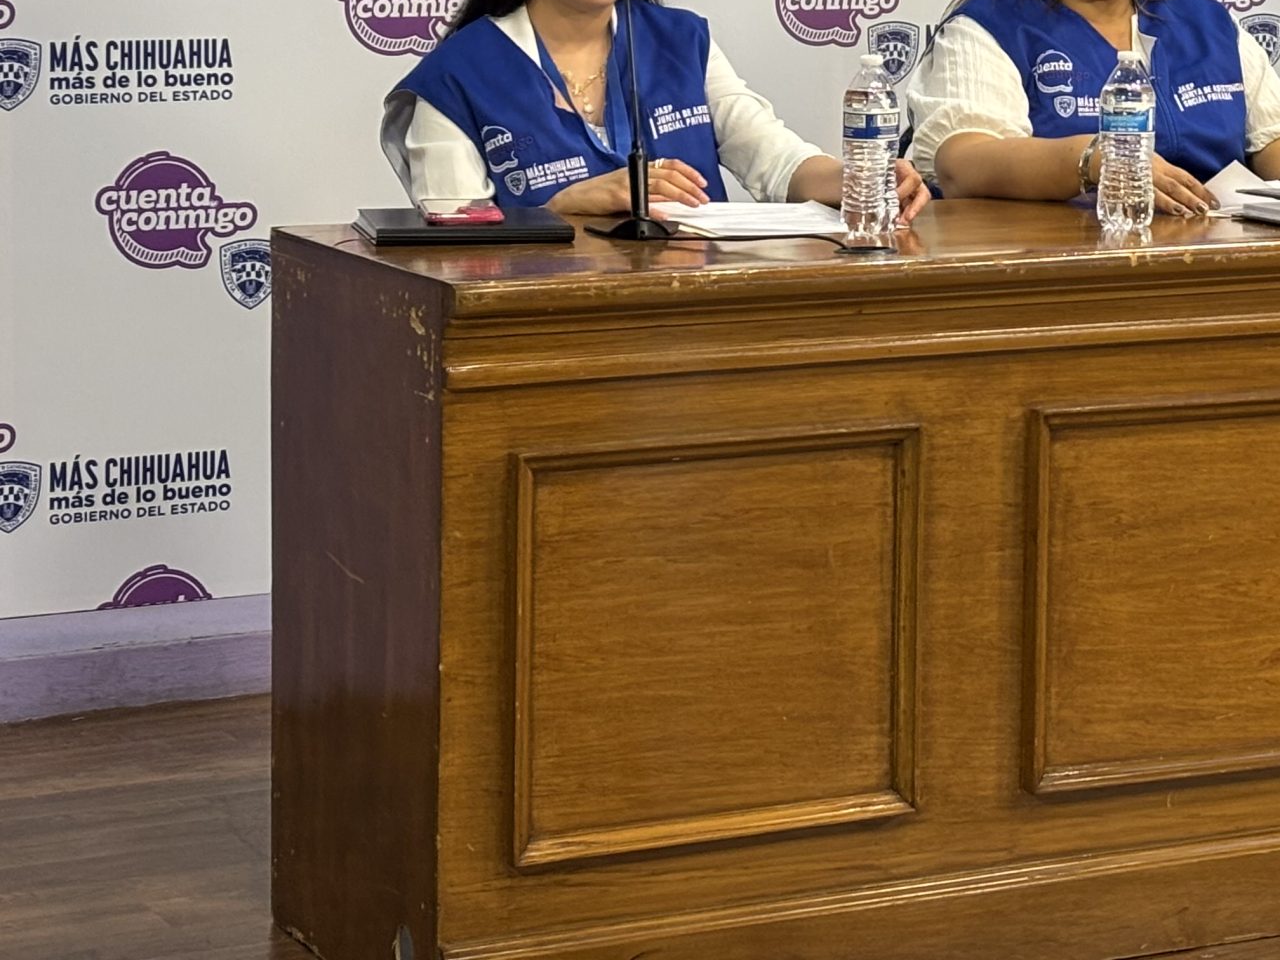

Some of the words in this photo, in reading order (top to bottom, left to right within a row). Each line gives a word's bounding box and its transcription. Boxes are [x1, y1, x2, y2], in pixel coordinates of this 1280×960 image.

[658, 120, 686, 134] SOCIAL
[100, 183, 210, 210] cuenta
[121, 201, 253, 233] conmigo
[50, 454, 98, 492] MÁS
[105, 450, 230, 488] CHIHUAHUA
[49, 491, 95, 510] más
[102, 488, 129, 506] de
[136, 486, 156, 503] lo
[163, 484, 231, 501] bueno
[50, 508, 132, 525] GOBIERNO
[137, 506, 166, 518] DEL
[171, 500, 230, 515] ESTADO
